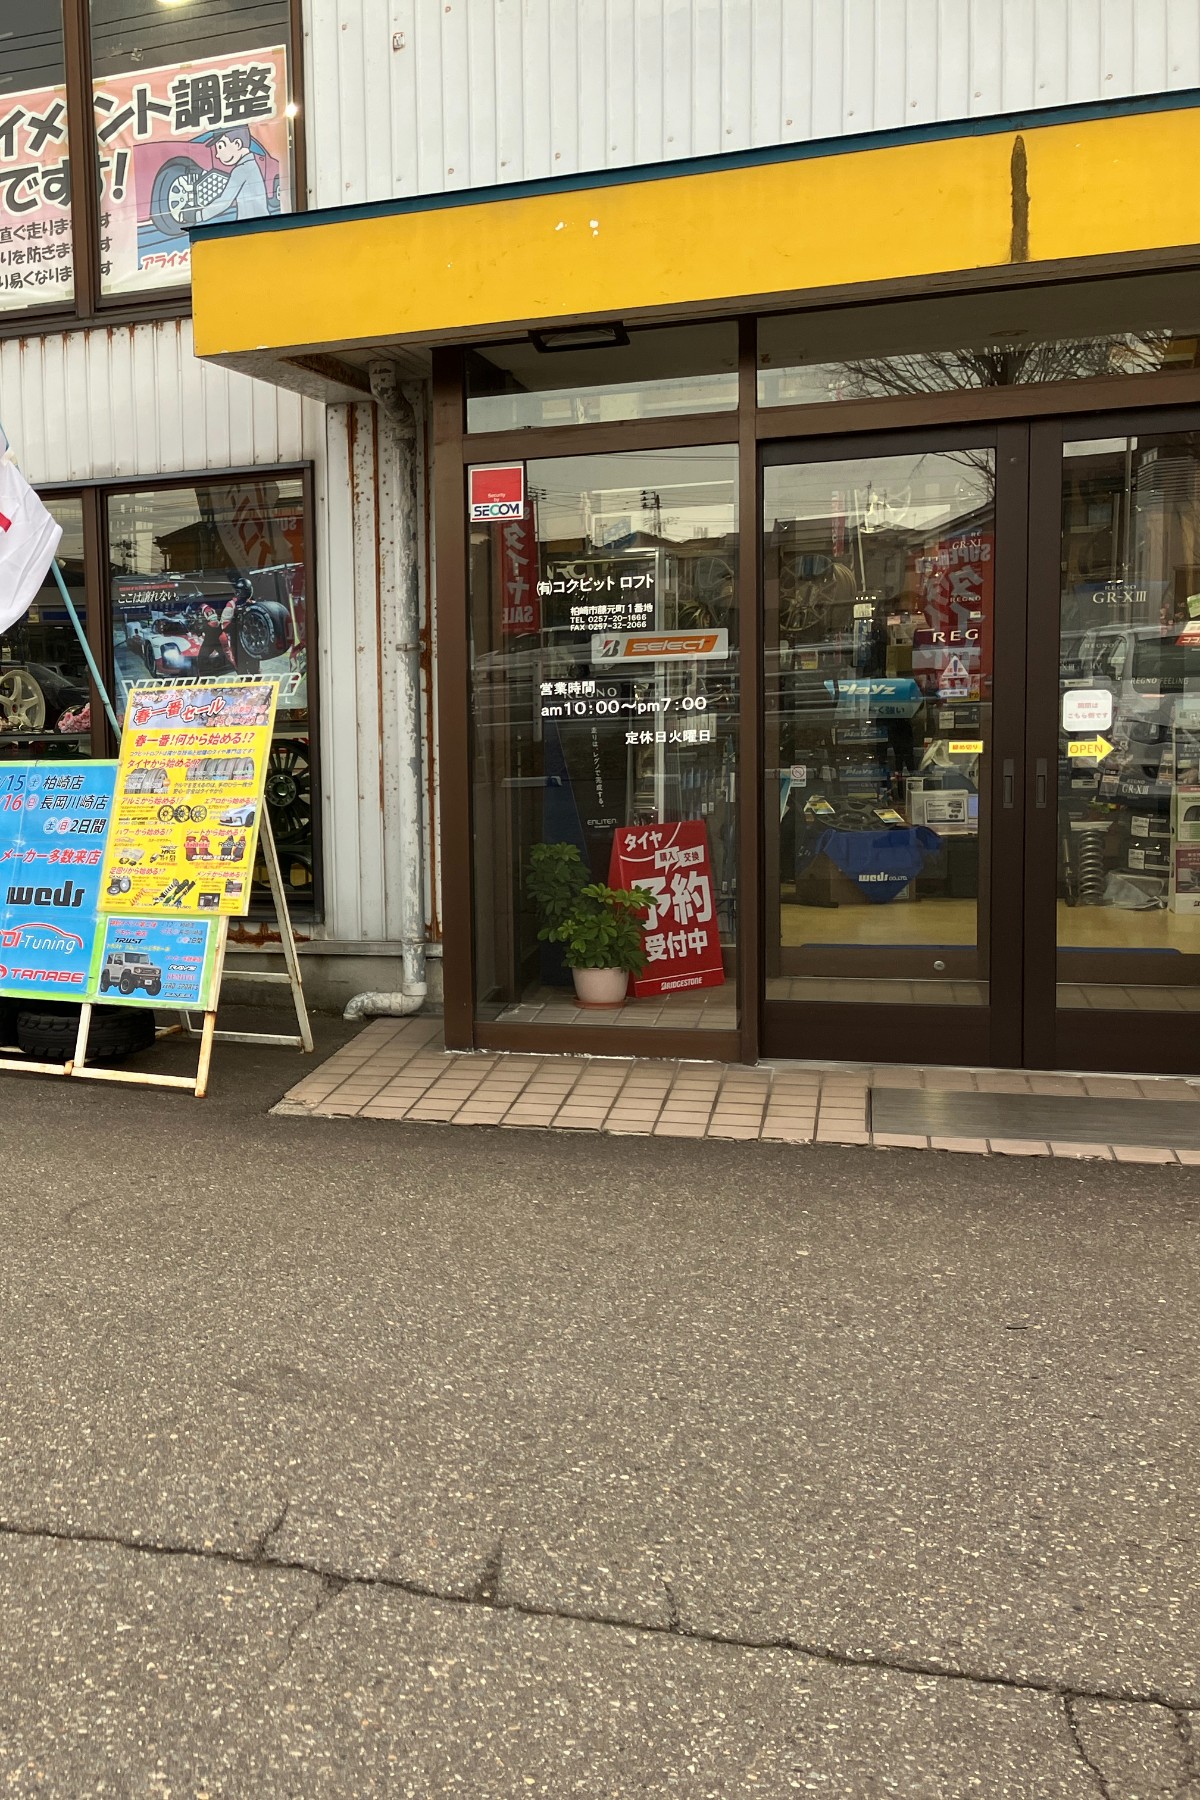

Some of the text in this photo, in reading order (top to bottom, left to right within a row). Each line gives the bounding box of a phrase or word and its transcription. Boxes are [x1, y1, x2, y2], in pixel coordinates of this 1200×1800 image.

[474, 503, 520, 517] SECOM
[621, 574, 654, 590] ロフト
[540, 681, 596, 696] 営業時間
[625, 729, 711, 745] 定休日火曜日
[1069, 745, 1103, 753] OPEN
[43, 775, 85, 790] 柏崎店
[40, 795, 109, 810] 長岡川崎店
[70, 819, 107, 834] 2日間
[624, 831, 662, 852] タイヤ
[0, 849, 102, 864] メーカー多数来店
[659, 851, 676, 863] 購入
[683, 851, 699, 863] 交換
[631, 871, 712, 931] 予約
[645, 928, 708, 962] 受付中
[11, 968, 85, 982] TANABE
[661, 976, 703, 990] BRIDGESTONE
